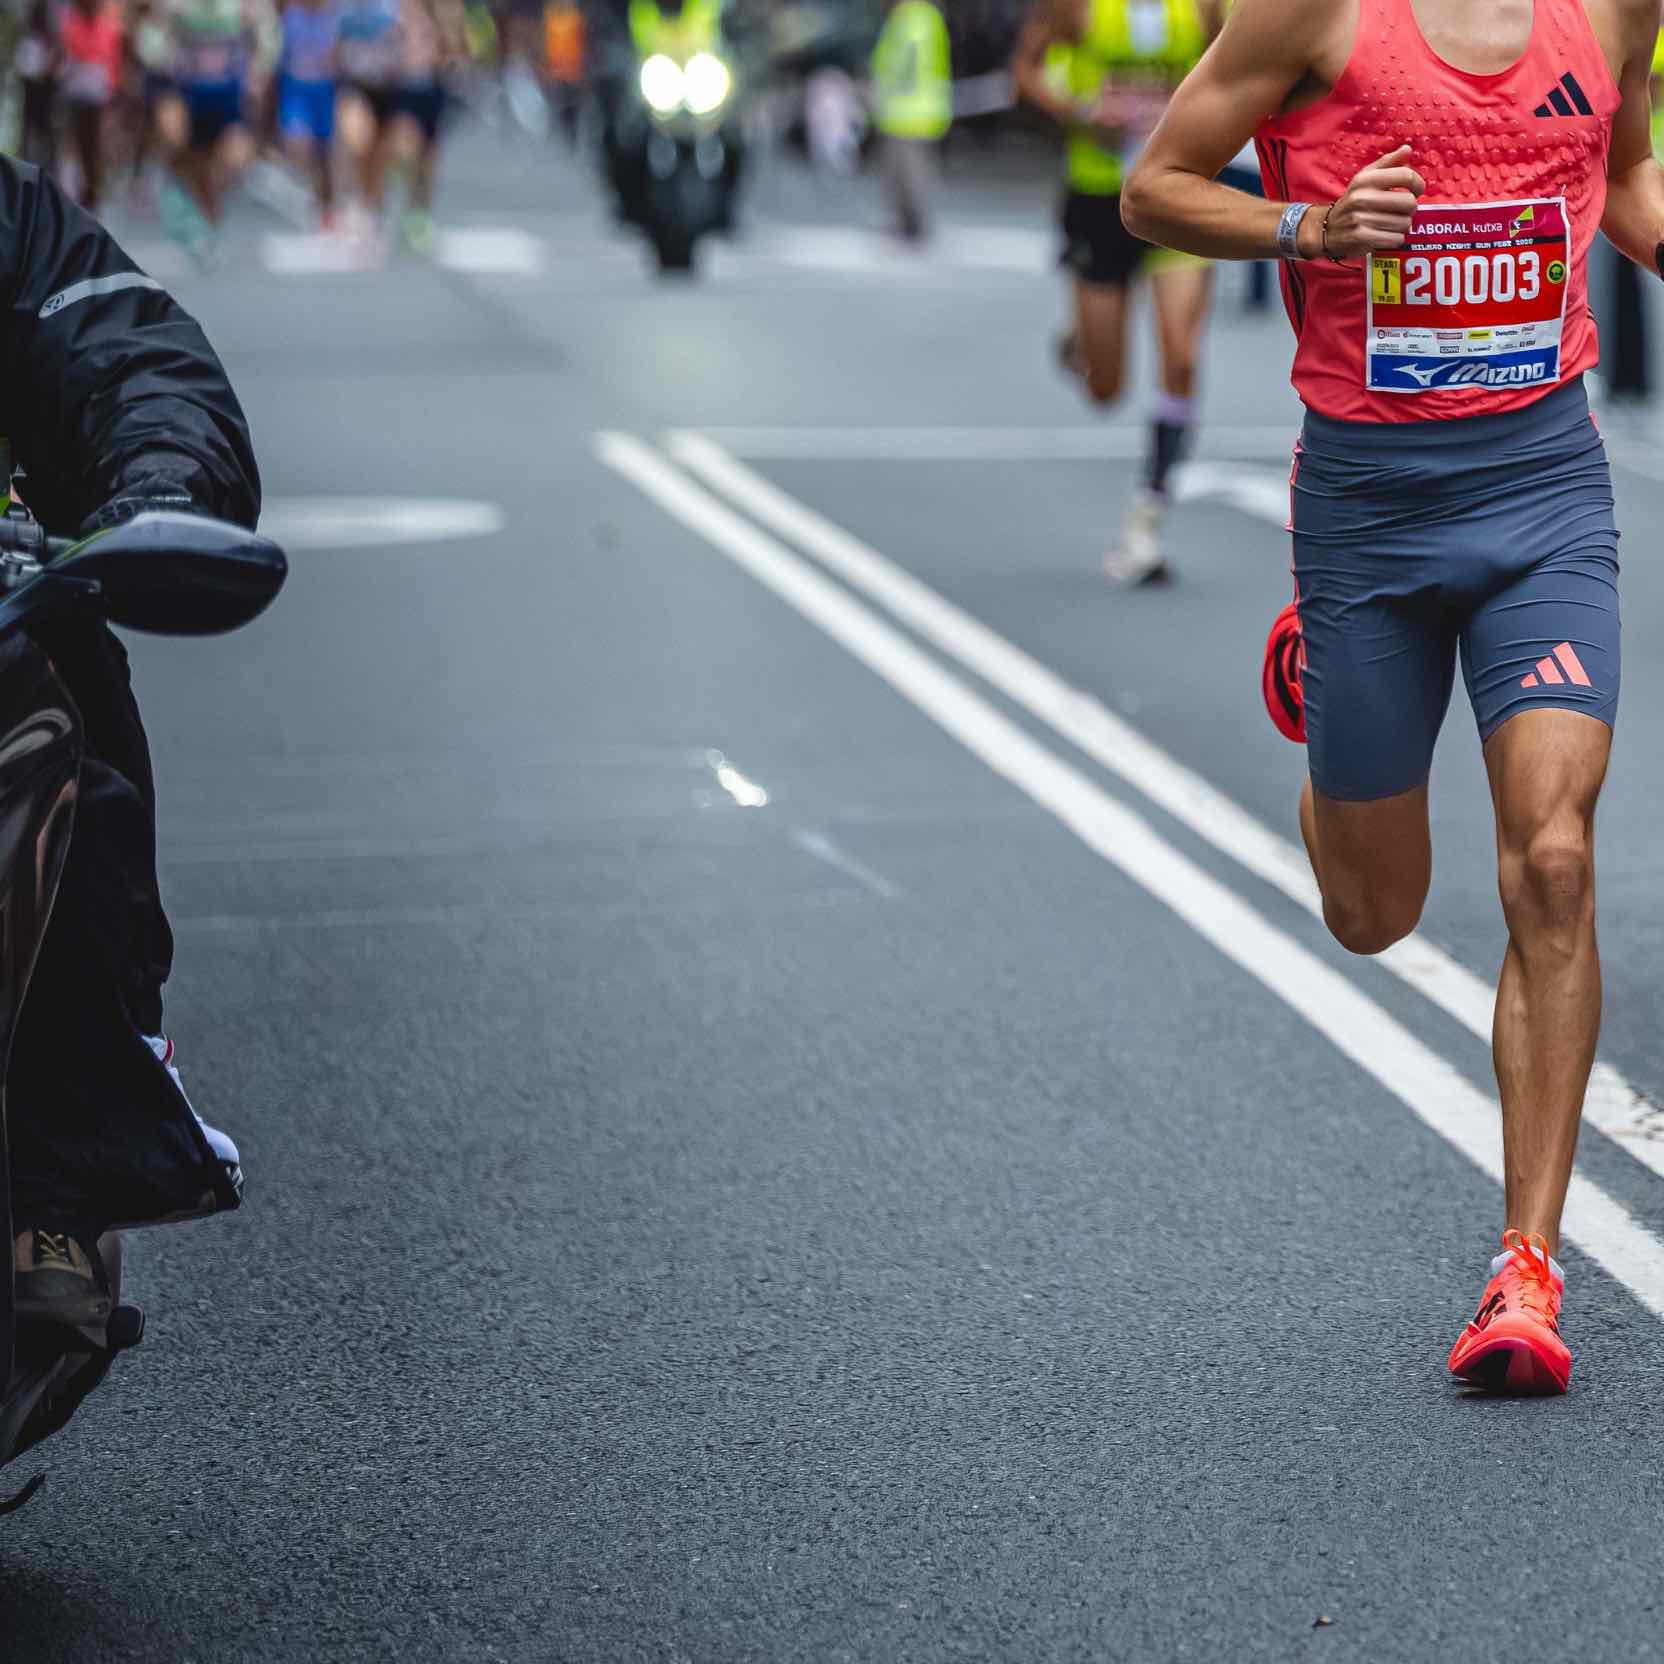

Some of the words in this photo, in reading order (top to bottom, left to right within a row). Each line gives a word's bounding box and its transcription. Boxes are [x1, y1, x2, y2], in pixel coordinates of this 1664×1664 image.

[1409, 223, 1469, 235] LABORAL
[1473, 222, 1503, 233] kutxa
[1374, 259, 1399, 269] START
[1382, 270, 1389, 294] 1
[1405, 251, 1540, 305] 20003
